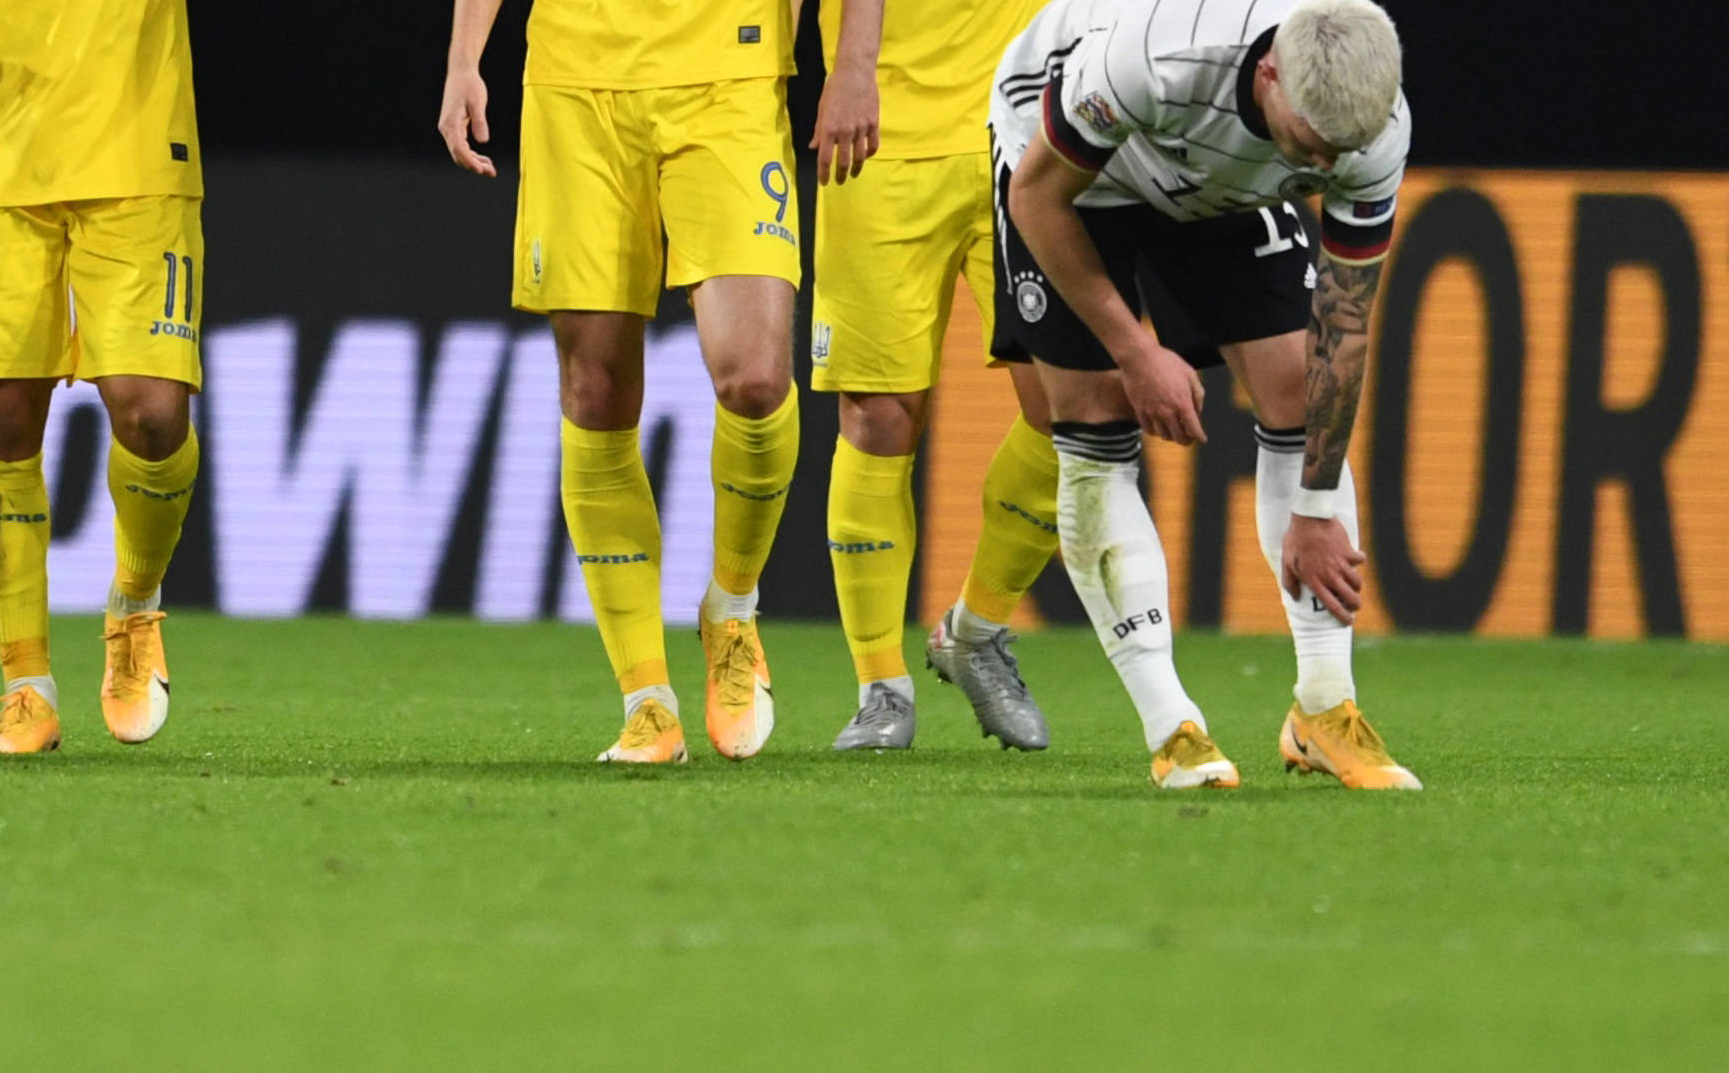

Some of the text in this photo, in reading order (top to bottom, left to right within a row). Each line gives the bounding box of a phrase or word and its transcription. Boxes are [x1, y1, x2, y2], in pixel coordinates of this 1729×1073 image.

[760, 161, 789, 223] 9
[163, 252, 192, 323] 11
[1112, 608, 1162, 640] DFB
